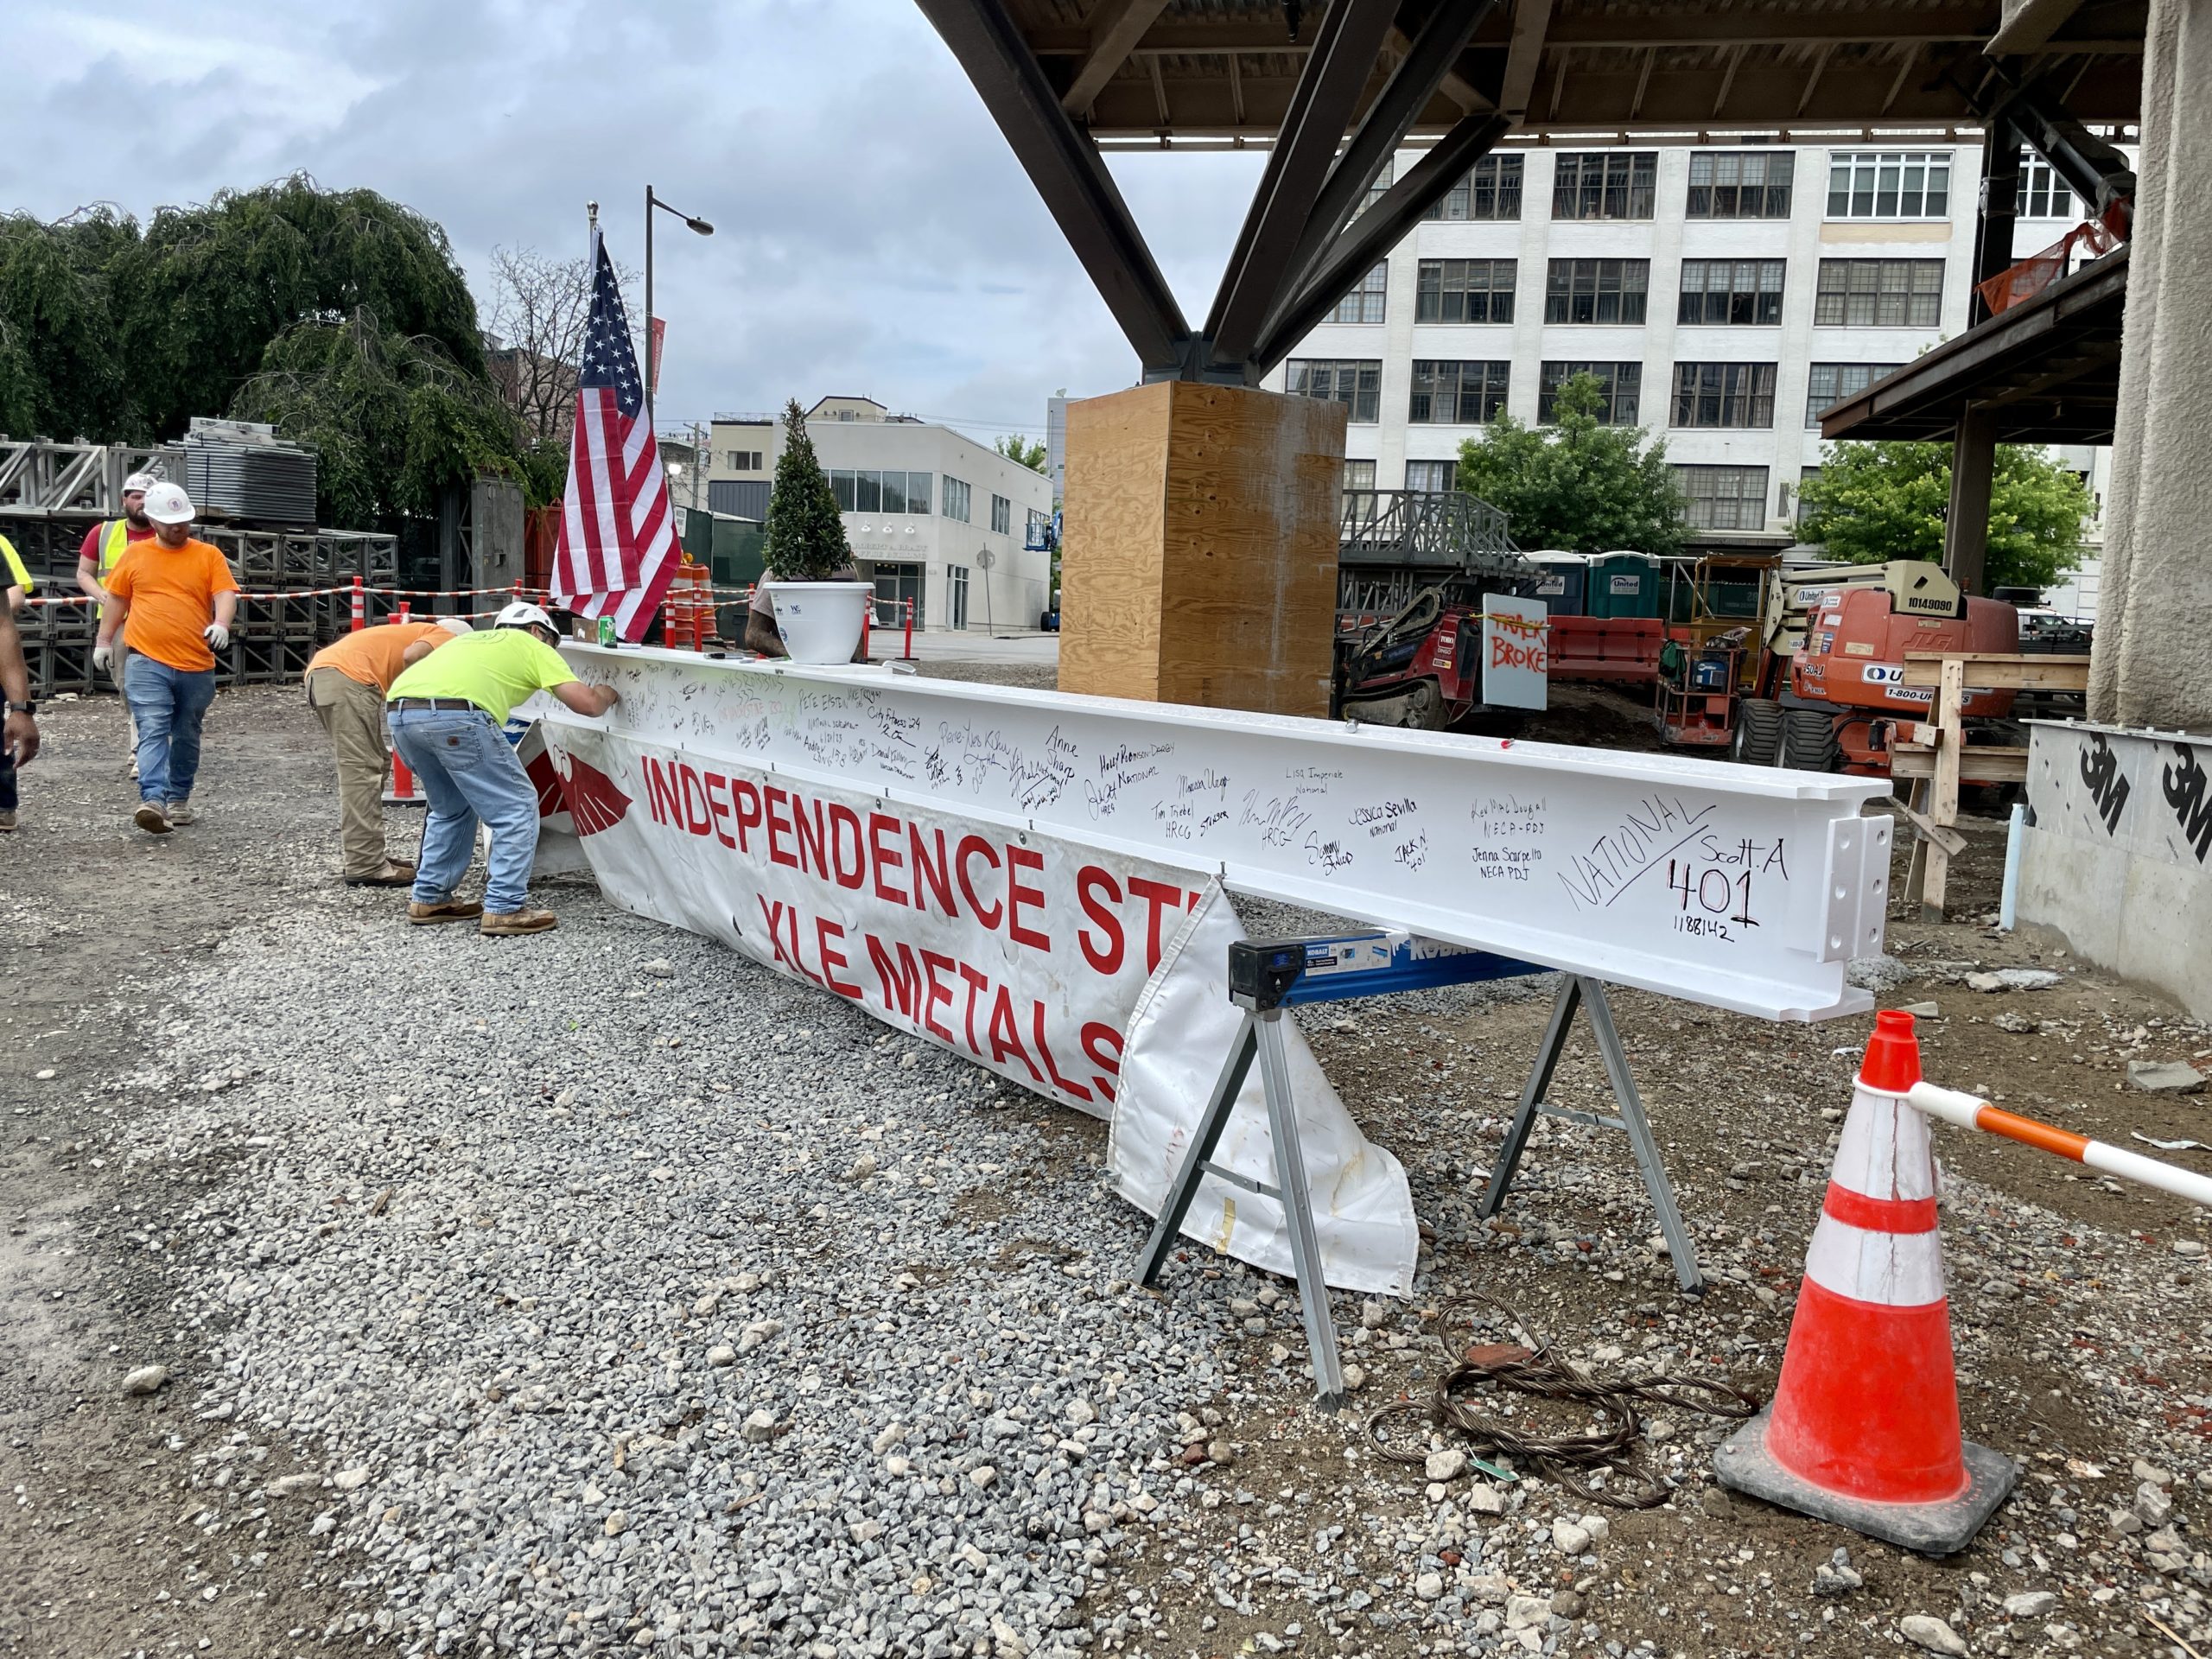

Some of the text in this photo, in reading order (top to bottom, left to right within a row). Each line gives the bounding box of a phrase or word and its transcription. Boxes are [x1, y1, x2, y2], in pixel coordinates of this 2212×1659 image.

[1440, 635, 1454, 644] TORO
[1492, 636, 1547, 673] BROKE
[868, 706, 884, 727] City
[1046, 725, 1079, 758] Anne
[641, 754, 1202, 978] INDEPENDENCE ST
[1471, 847, 1500, 862] Jenna
[1557, 794, 1717, 912] NATIONAL
[1480, 865, 1530, 881] NECA PDJ
[1667, 858, 1760, 929] 401
[1306, 947, 1329, 957] KOBALT
[757, 892, 1124, 1104] XLE METALS
